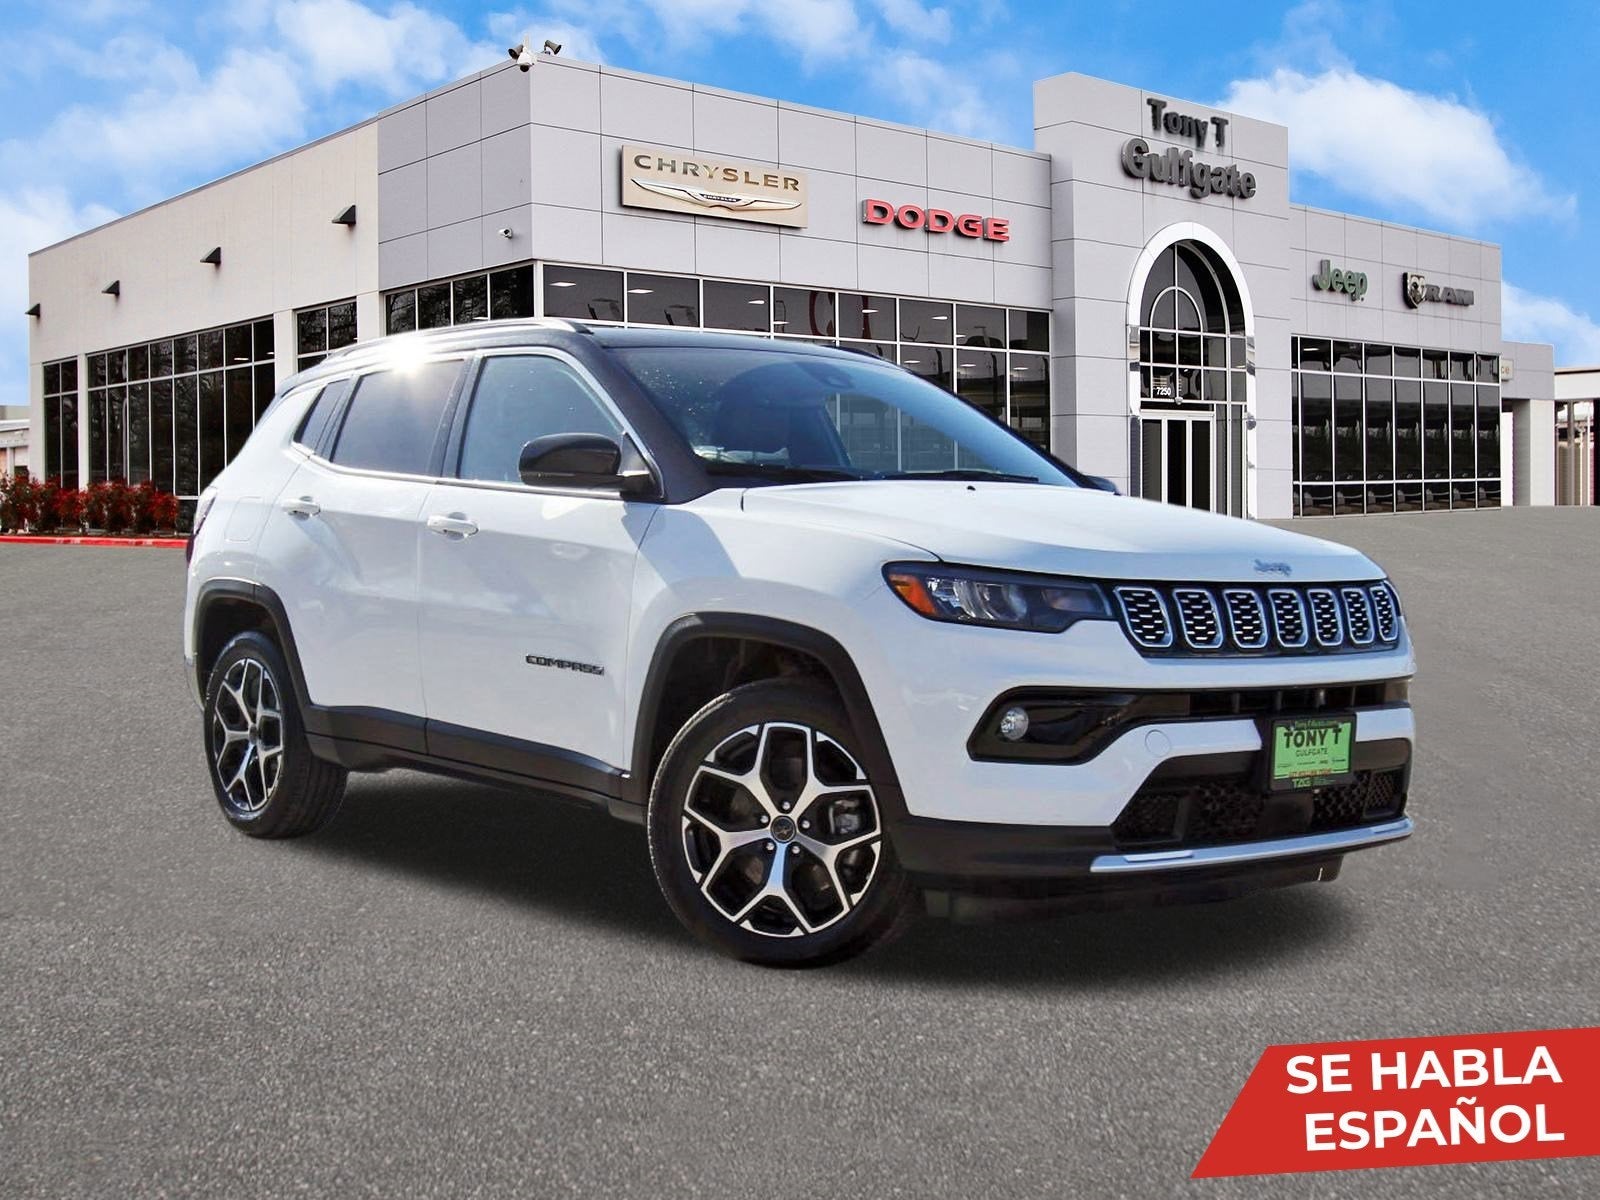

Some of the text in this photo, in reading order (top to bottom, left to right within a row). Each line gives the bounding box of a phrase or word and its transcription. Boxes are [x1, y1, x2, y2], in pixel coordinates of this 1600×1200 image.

[1146, 98, 1229, 148] Tony T
[633, 154, 800, 192] CHRYSLER
[1121, 138, 1257, 199] Gulfgate
[862, 198, 1010, 243] DODGE
[1312, 259, 1368, 302] Jeep
[1424, 284, 1475, 307] RAM
[1156, 386, 1172, 396] 7250
[525, 655, 605, 676] COMPASS
[1283, 727, 1342, 749] TONY T
